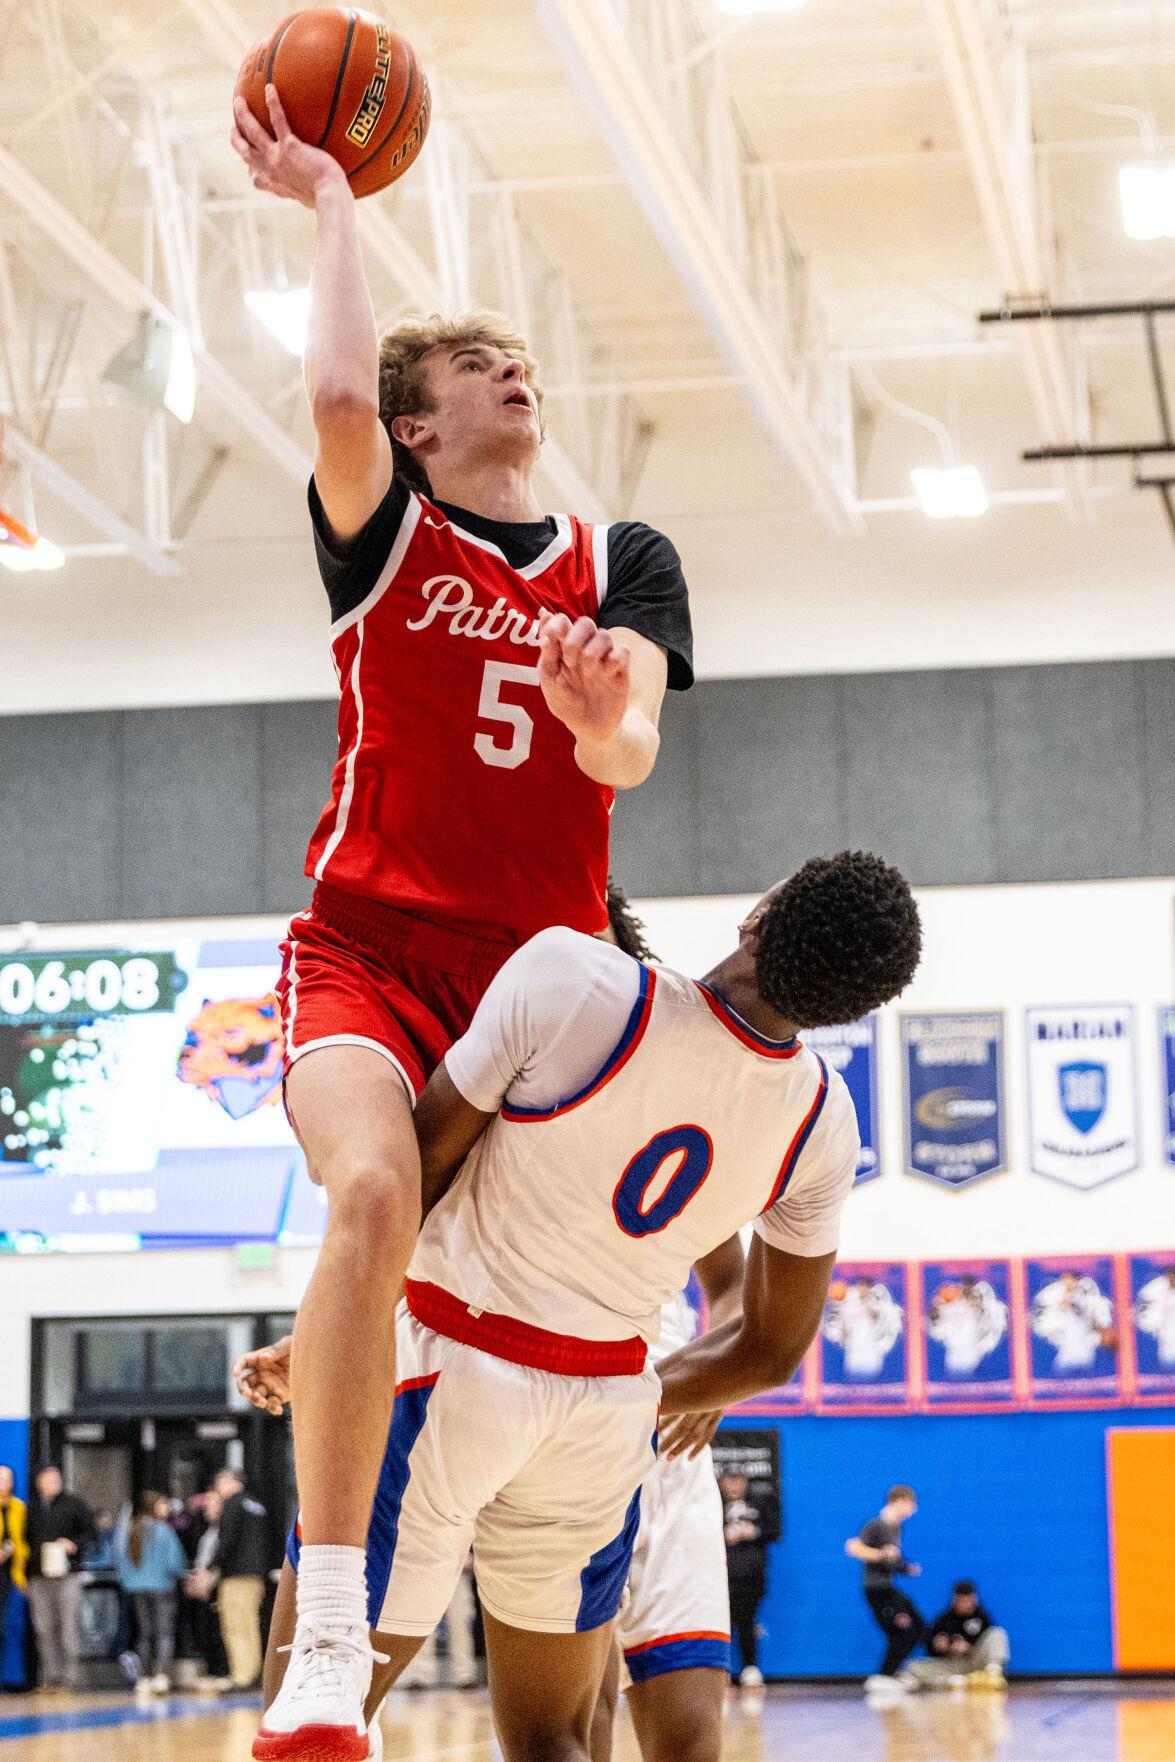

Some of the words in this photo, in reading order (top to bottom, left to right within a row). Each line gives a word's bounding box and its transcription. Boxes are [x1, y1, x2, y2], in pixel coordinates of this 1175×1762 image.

[406, 574, 549, 647] Patri
[473, 659, 541, 770] 5
[0, 958, 160, 1015] 06:08
[612, 1123, 714, 1238] 0
